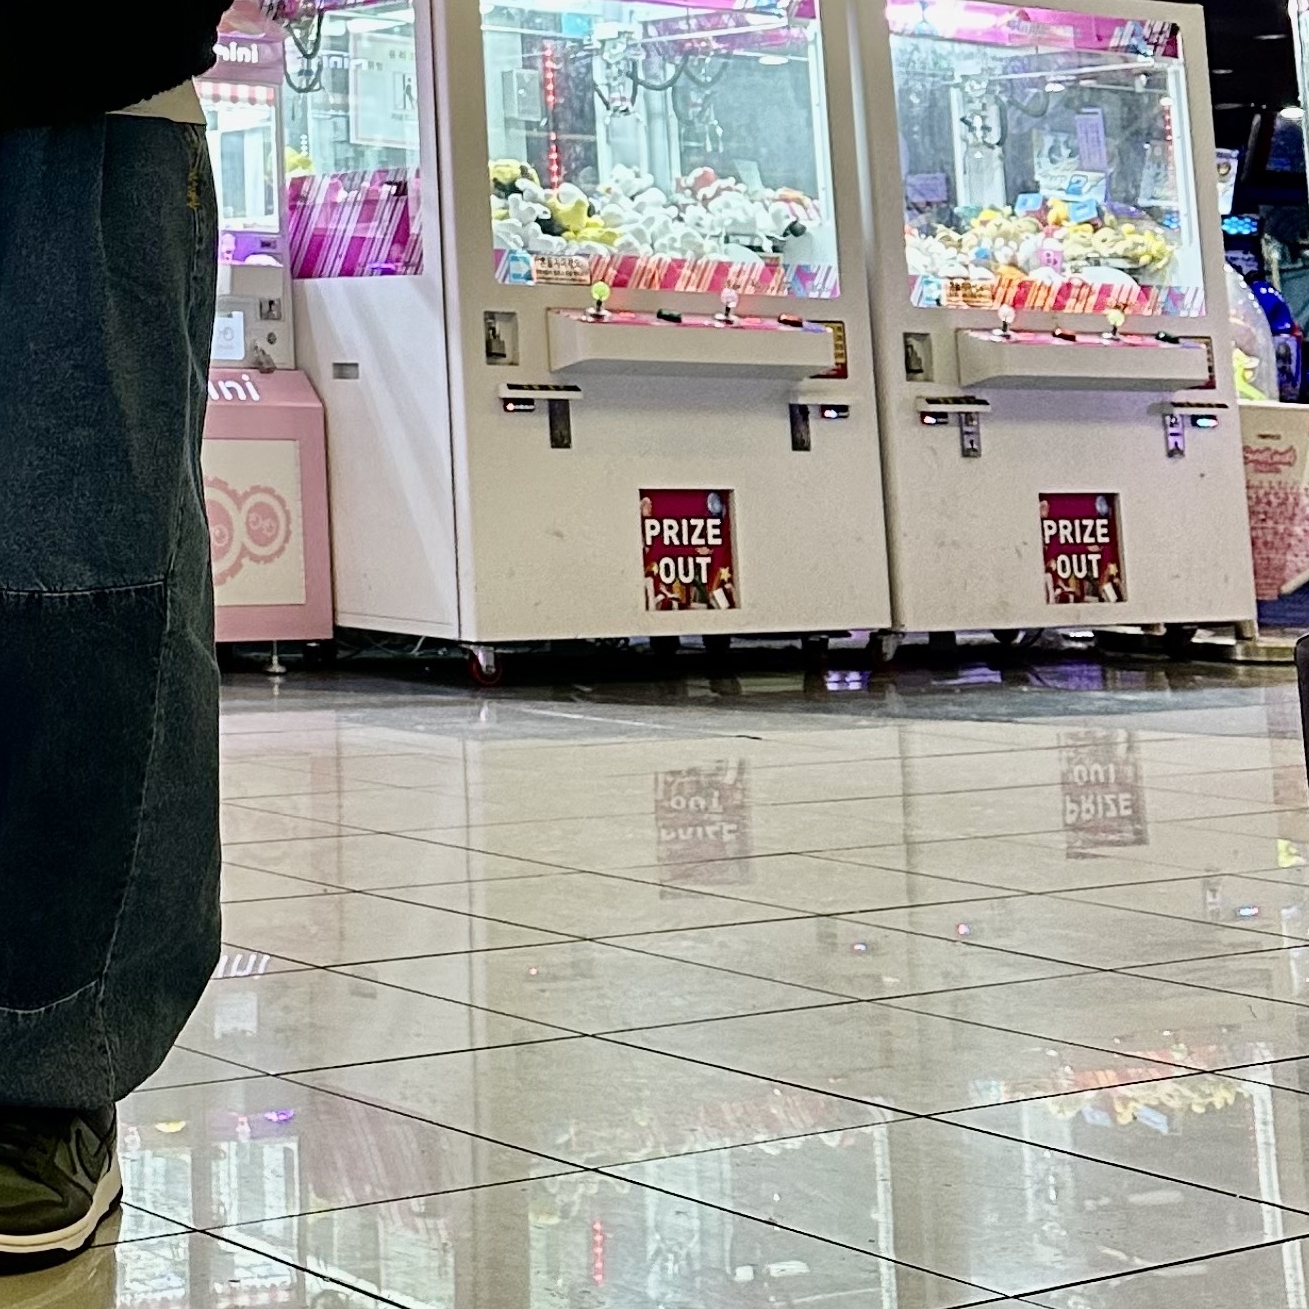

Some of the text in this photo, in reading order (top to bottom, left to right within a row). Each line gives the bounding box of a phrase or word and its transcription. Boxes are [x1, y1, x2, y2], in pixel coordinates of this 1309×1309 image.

[644, 518, 722, 545] PRIZE
[1043, 519, 1110, 544] PRIZE
[659, 556, 711, 584] OUT
[1057, 554, 1101, 579] OUT
